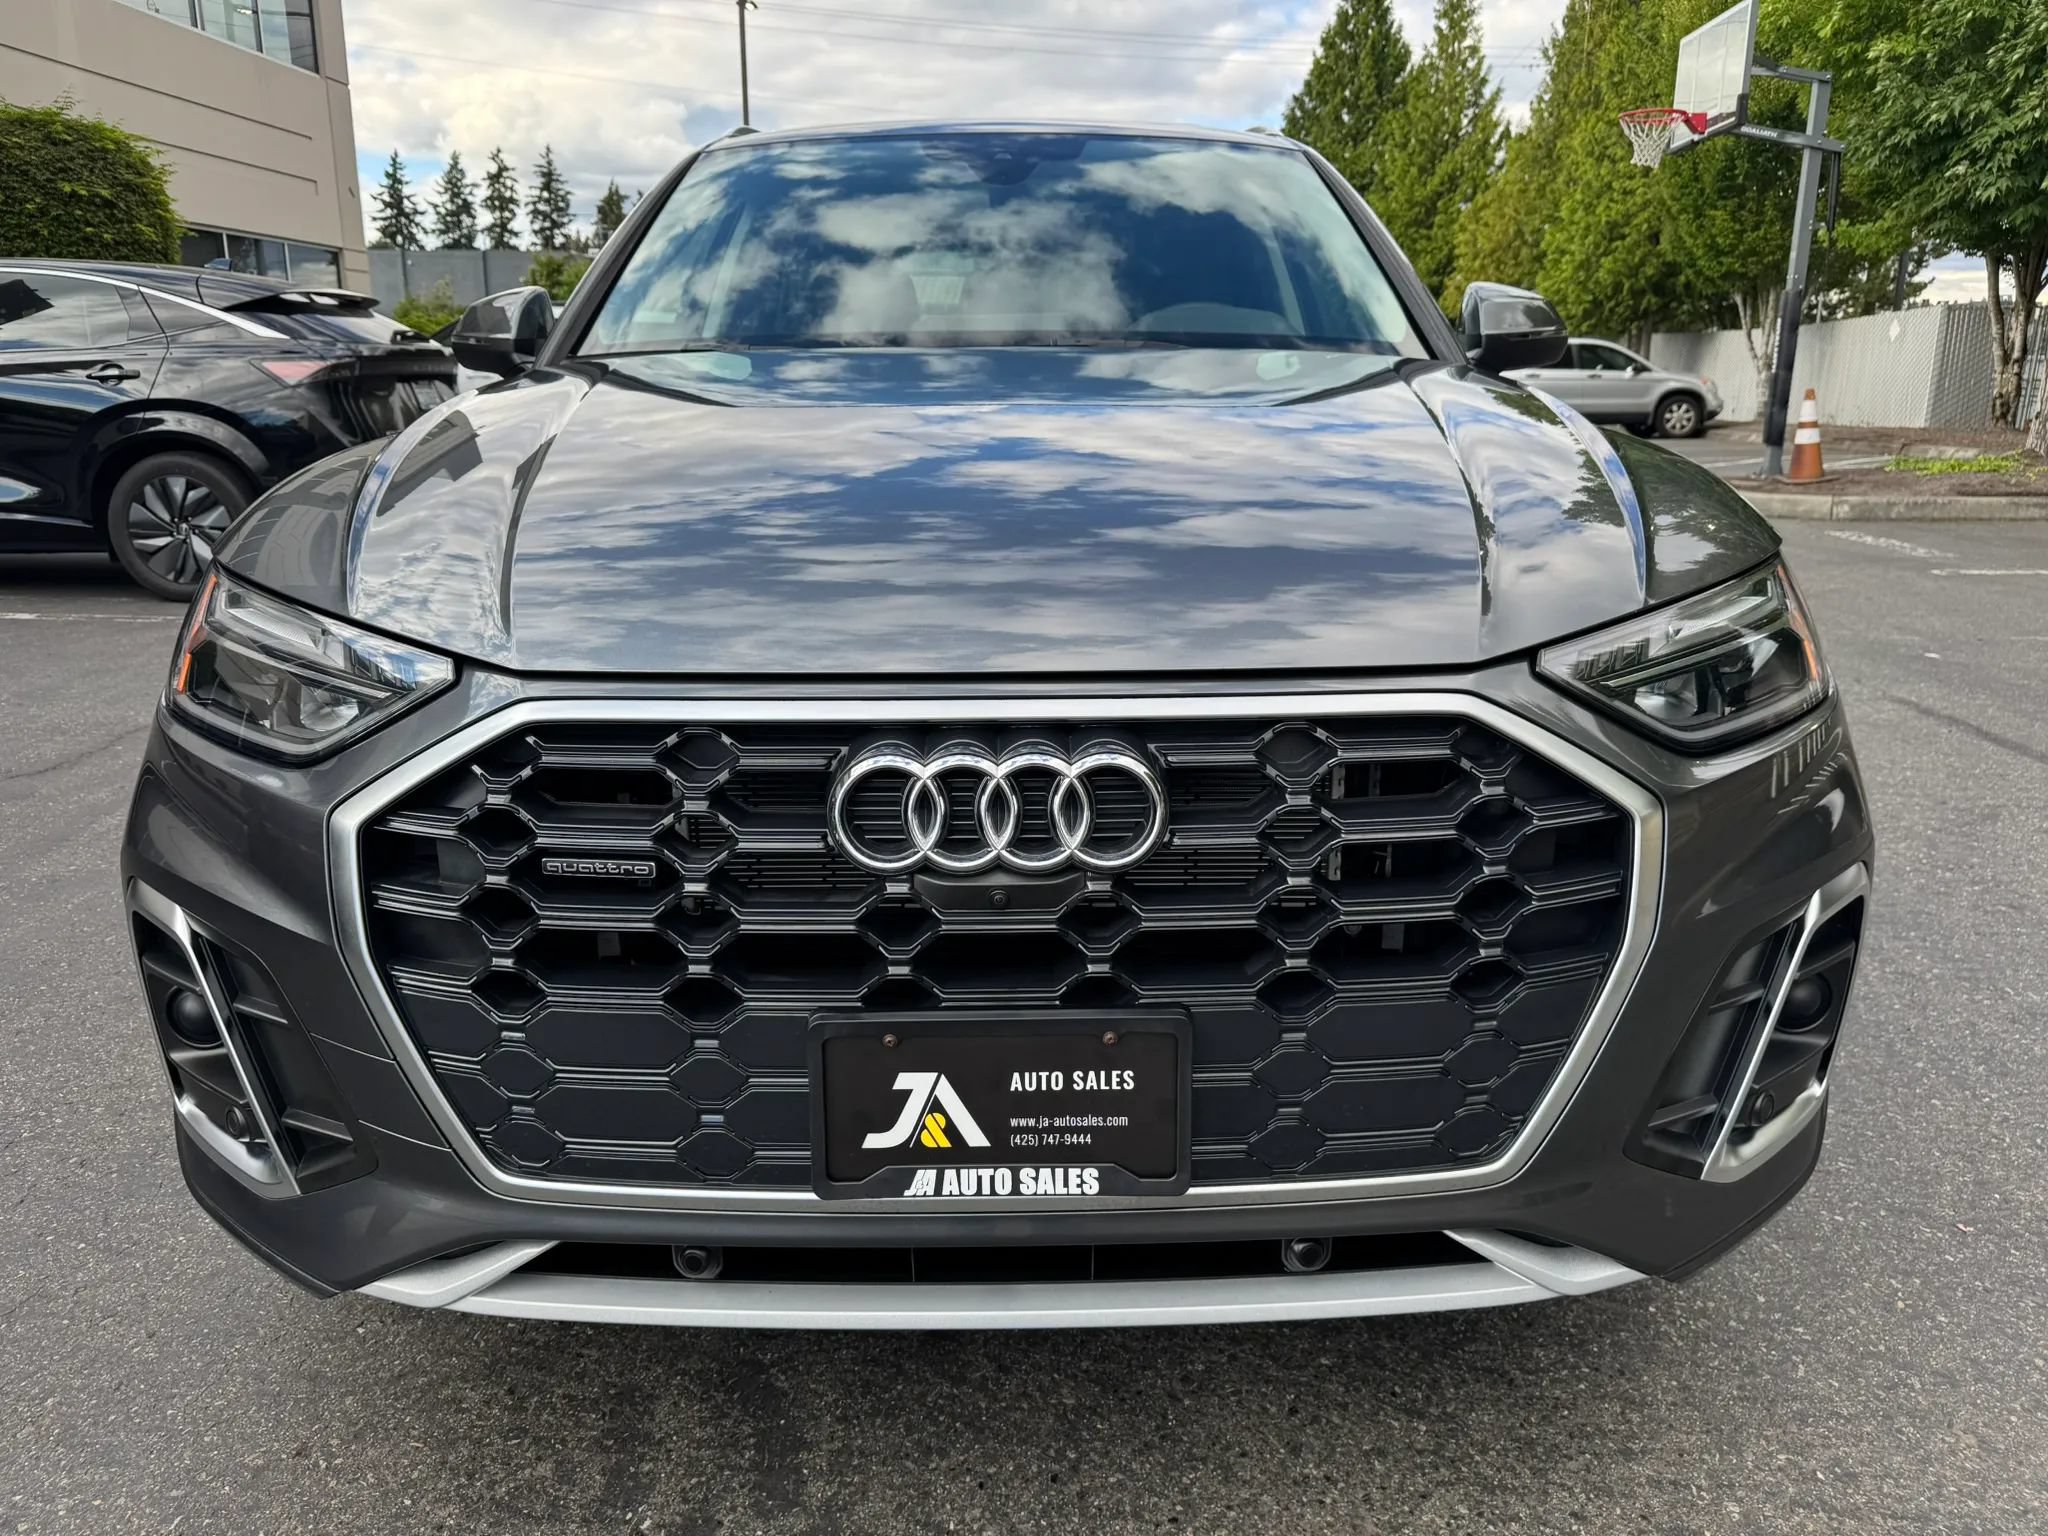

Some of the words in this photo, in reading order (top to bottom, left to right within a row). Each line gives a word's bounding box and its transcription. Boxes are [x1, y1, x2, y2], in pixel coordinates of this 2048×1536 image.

[546, 862, 649, 874] quattro
[1010, 1071, 1064, 1092] AUTO
[1072, 1070, 1135, 1091] SALES
[1010, 1114, 1129, 1130] www.ja-autosales.com
[1010, 1133, 1039, 1147] (425)
[1041, 1132, 1092, 1146] 747-9444
[942, 1168, 1012, 1197] AUTO
[1019, 1167, 1100, 1196] SALES
